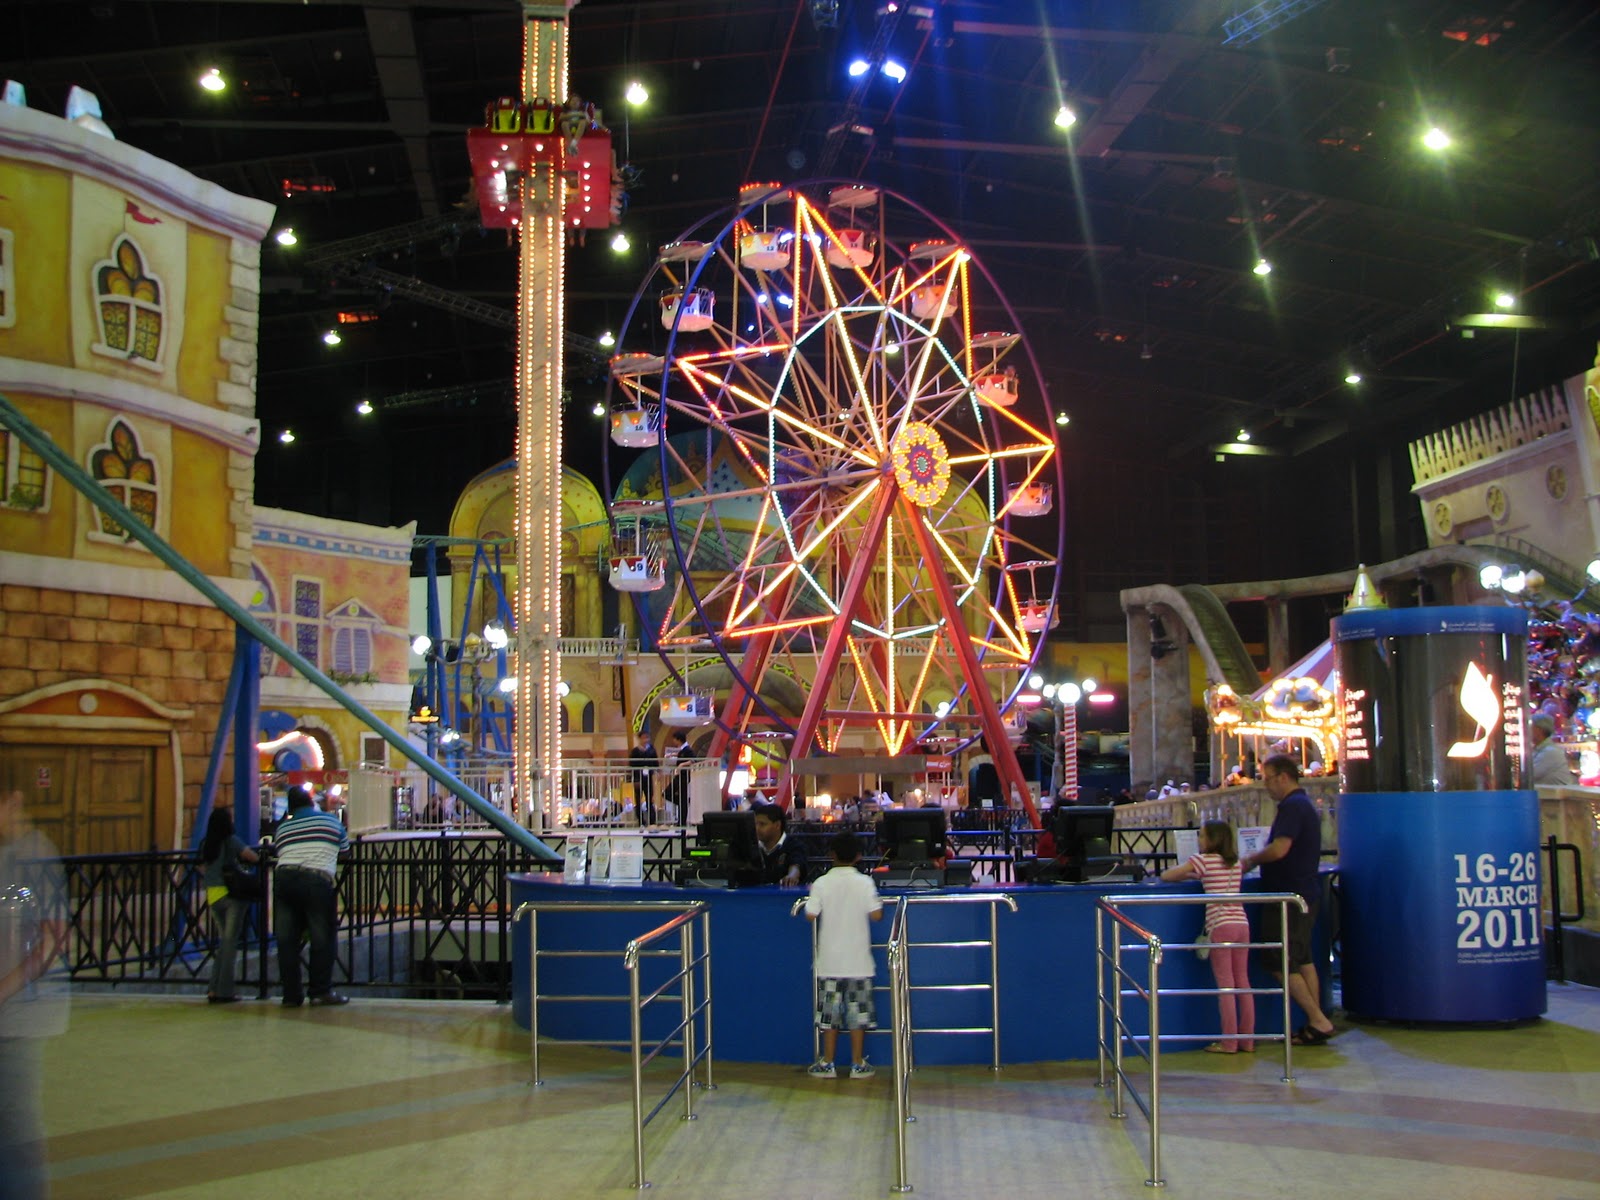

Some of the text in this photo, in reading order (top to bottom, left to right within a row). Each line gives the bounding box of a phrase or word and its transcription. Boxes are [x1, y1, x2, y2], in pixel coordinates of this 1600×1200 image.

[1035, 496, 1041, 504] 2
[636, 562, 644, 571] 9
[686, 704, 693, 712] 8
[1010, 719, 1016, 727] 4
[1454, 852, 1536, 883] 16-26
[1456, 884, 1538, 907] MARCH
[1457, 907, 1540, 949] 2011
